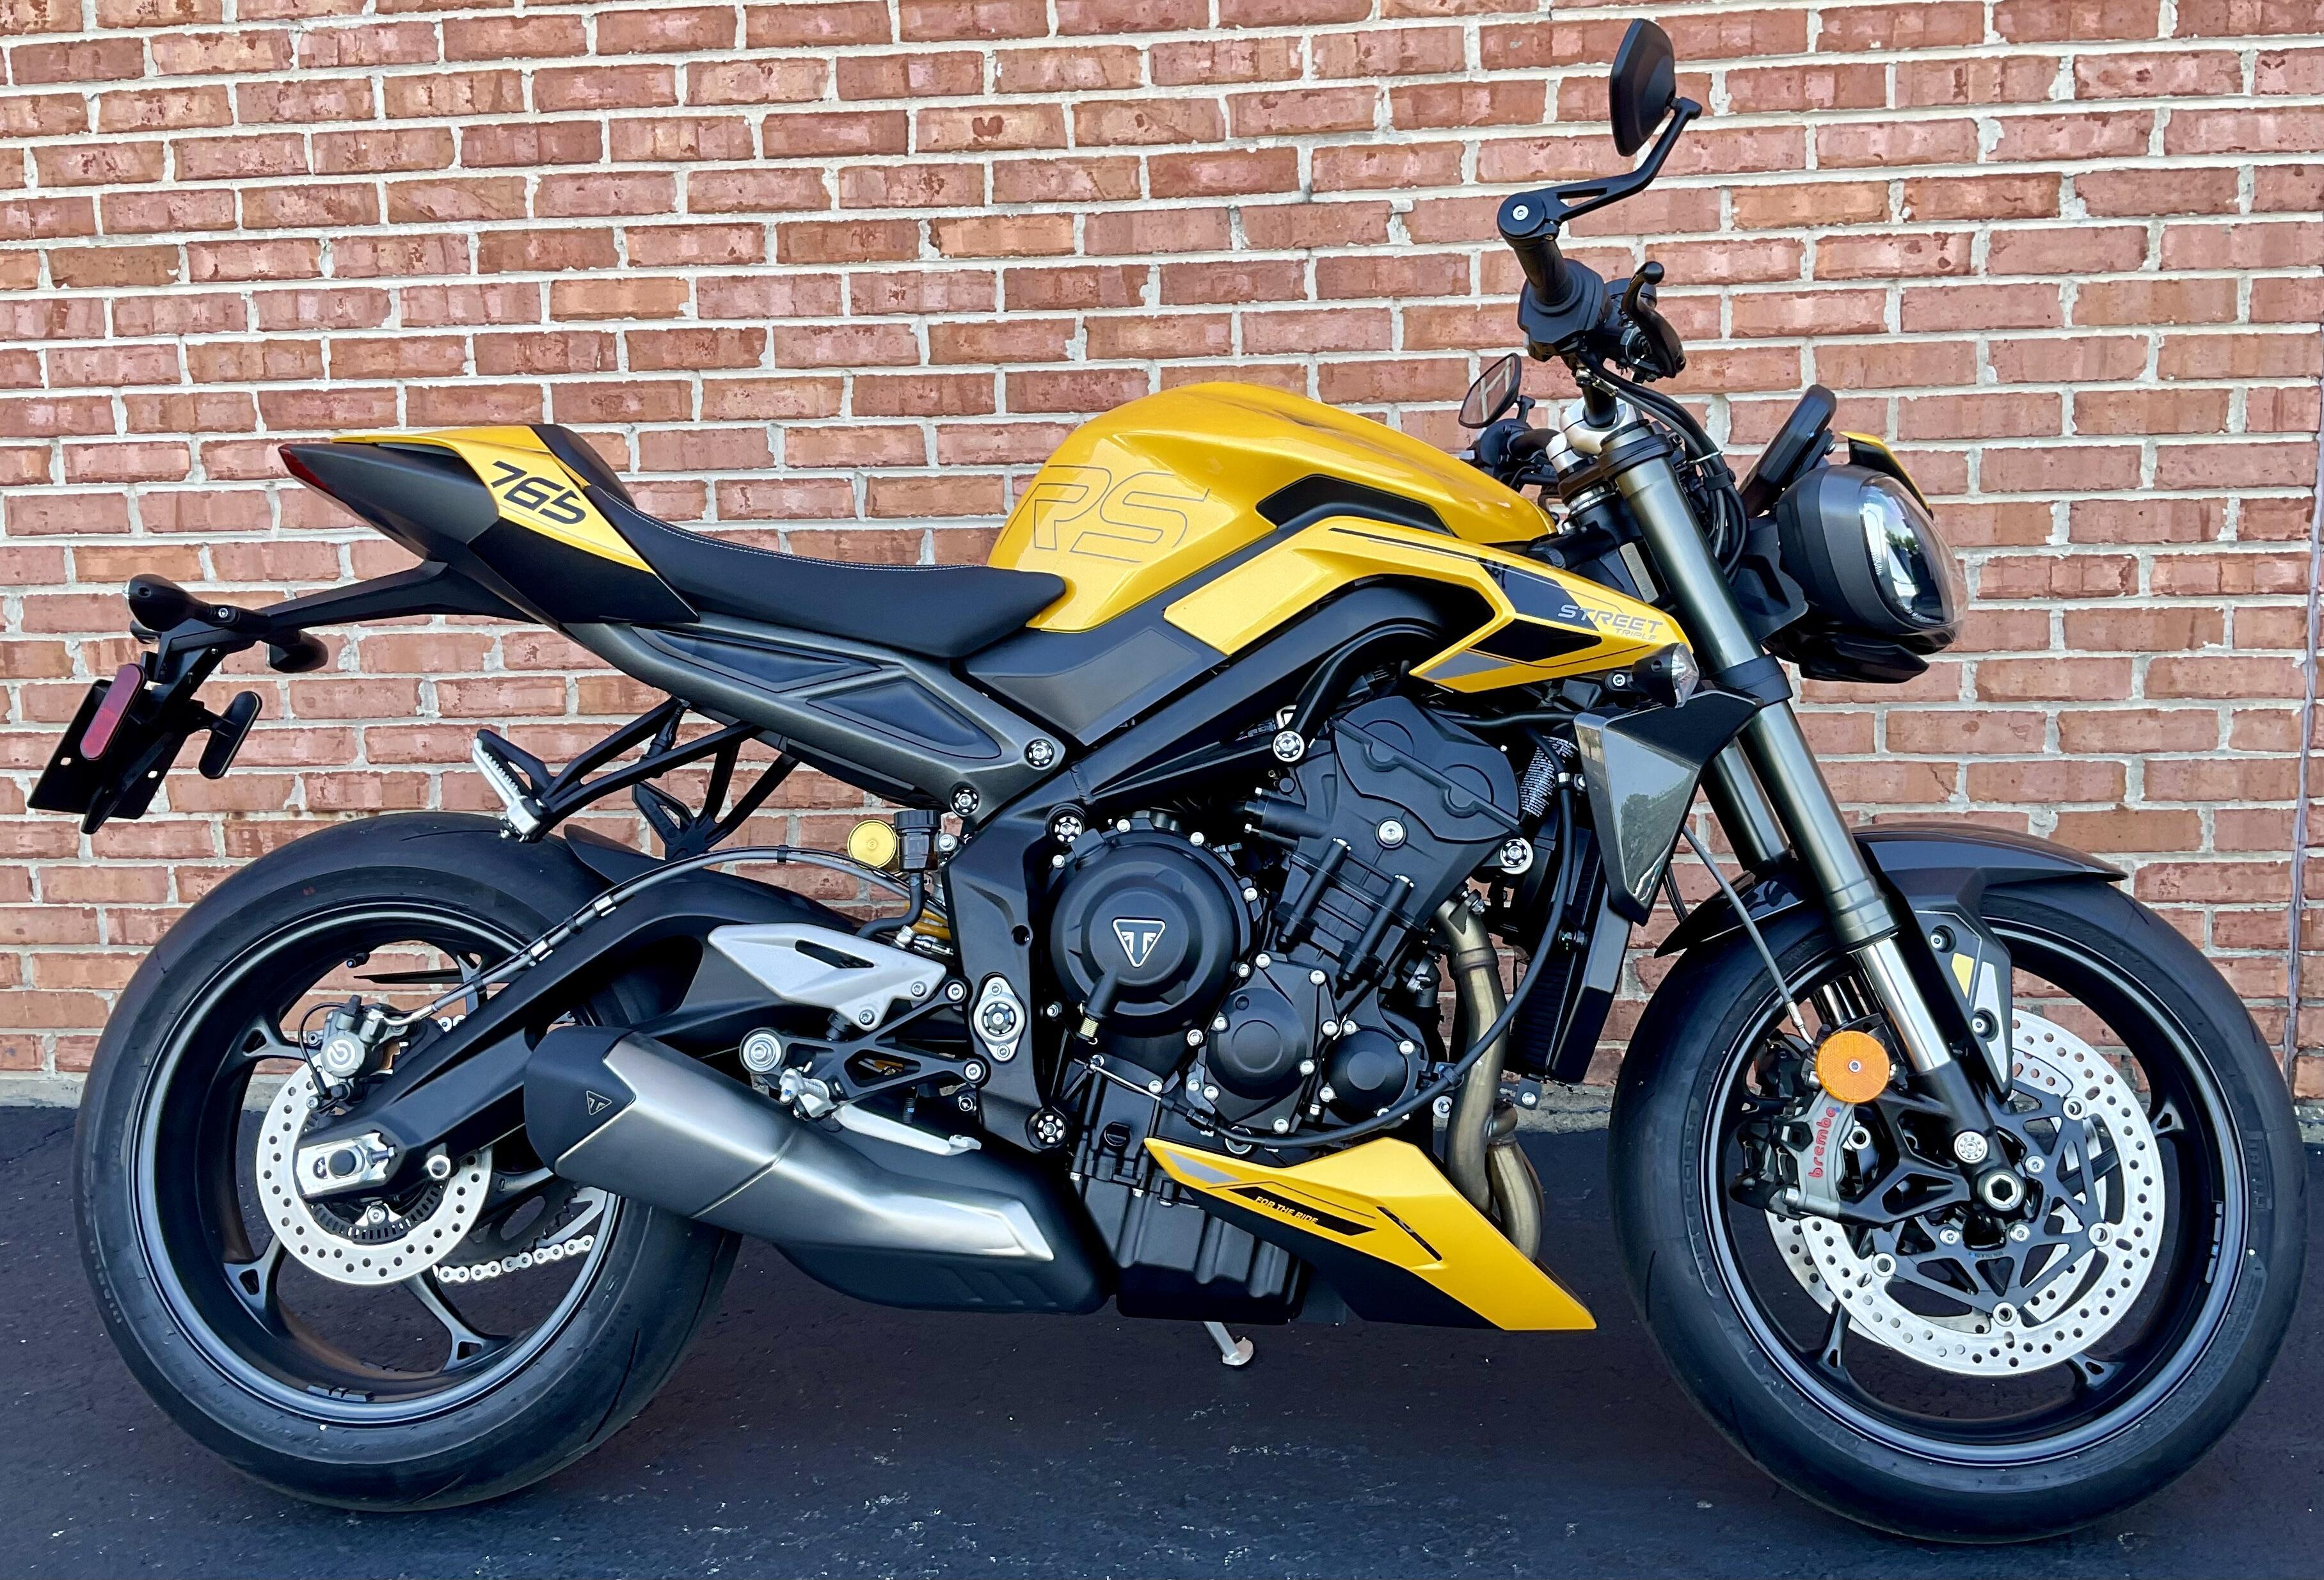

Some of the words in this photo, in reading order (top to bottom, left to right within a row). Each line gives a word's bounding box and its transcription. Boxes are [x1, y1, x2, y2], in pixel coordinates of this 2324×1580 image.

[491, 460, 587, 525] 765
[999, 465, 1211, 563] RS
[1557, 604, 1664, 634] STREET
[1615, 628, 1657, 642] TRIPLE
[1808, 1106, 1836, 1179] brembo
[1255, 1195, 1276, 1208] FOR
[1277, 1204, 1296, 1215] THE
[1296, 1211, 1319, 1224] RIDE
